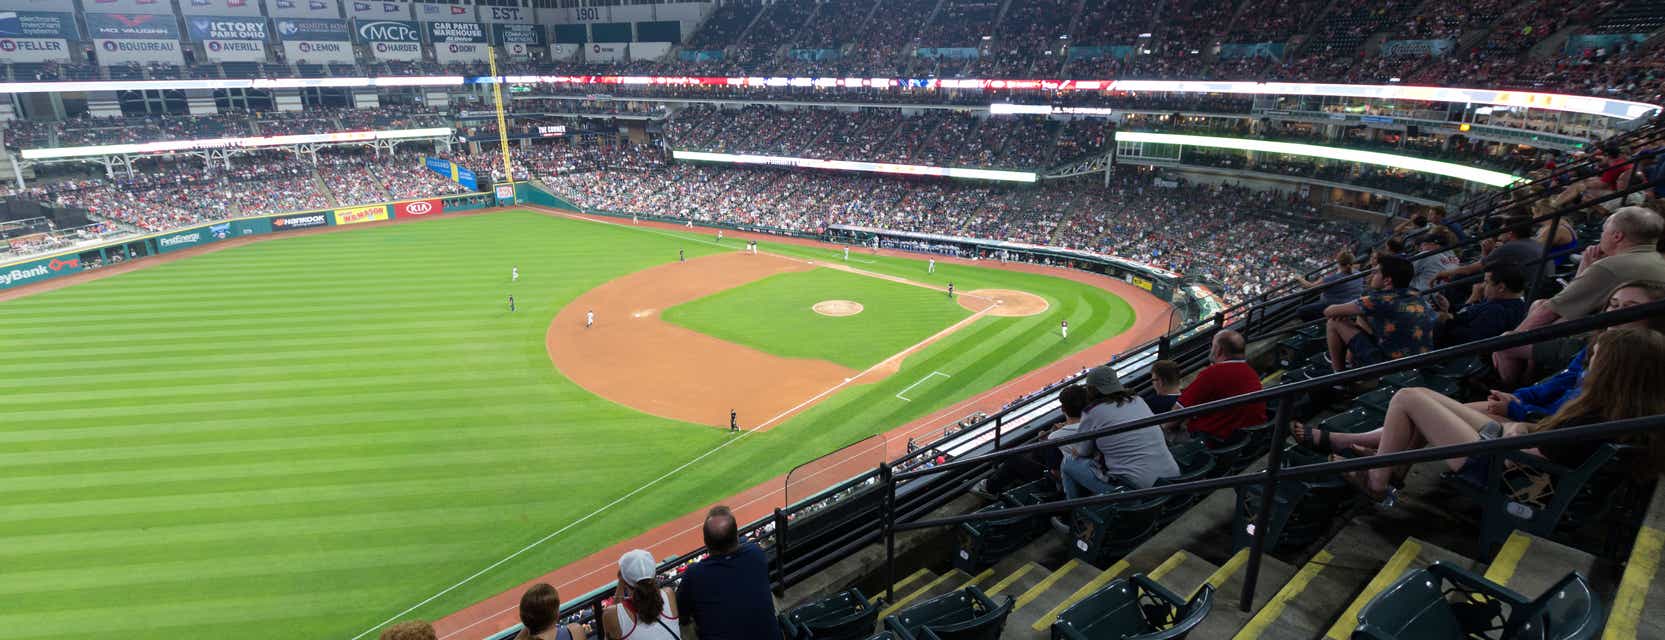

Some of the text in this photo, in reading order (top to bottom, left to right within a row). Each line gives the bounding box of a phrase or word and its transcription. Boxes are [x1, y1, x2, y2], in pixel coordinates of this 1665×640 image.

[492, 8, 600, 21] EST. 1901
[434, 22, 479, 31] CAR PARTS
[433, 29, 482, 37] WAREHOUSE
[16, 41, 63, 51] FELLER
[118, 41, 175, 51] BOUDREAU
[223, 43, 261, 52] AVERILL
[311, 44, 342, 53] LEMON
[387, 44, 419, 53] HARDER
[410, 204, 428, 213] KIA
[160, 233, 200, 247] FirstEnergy
